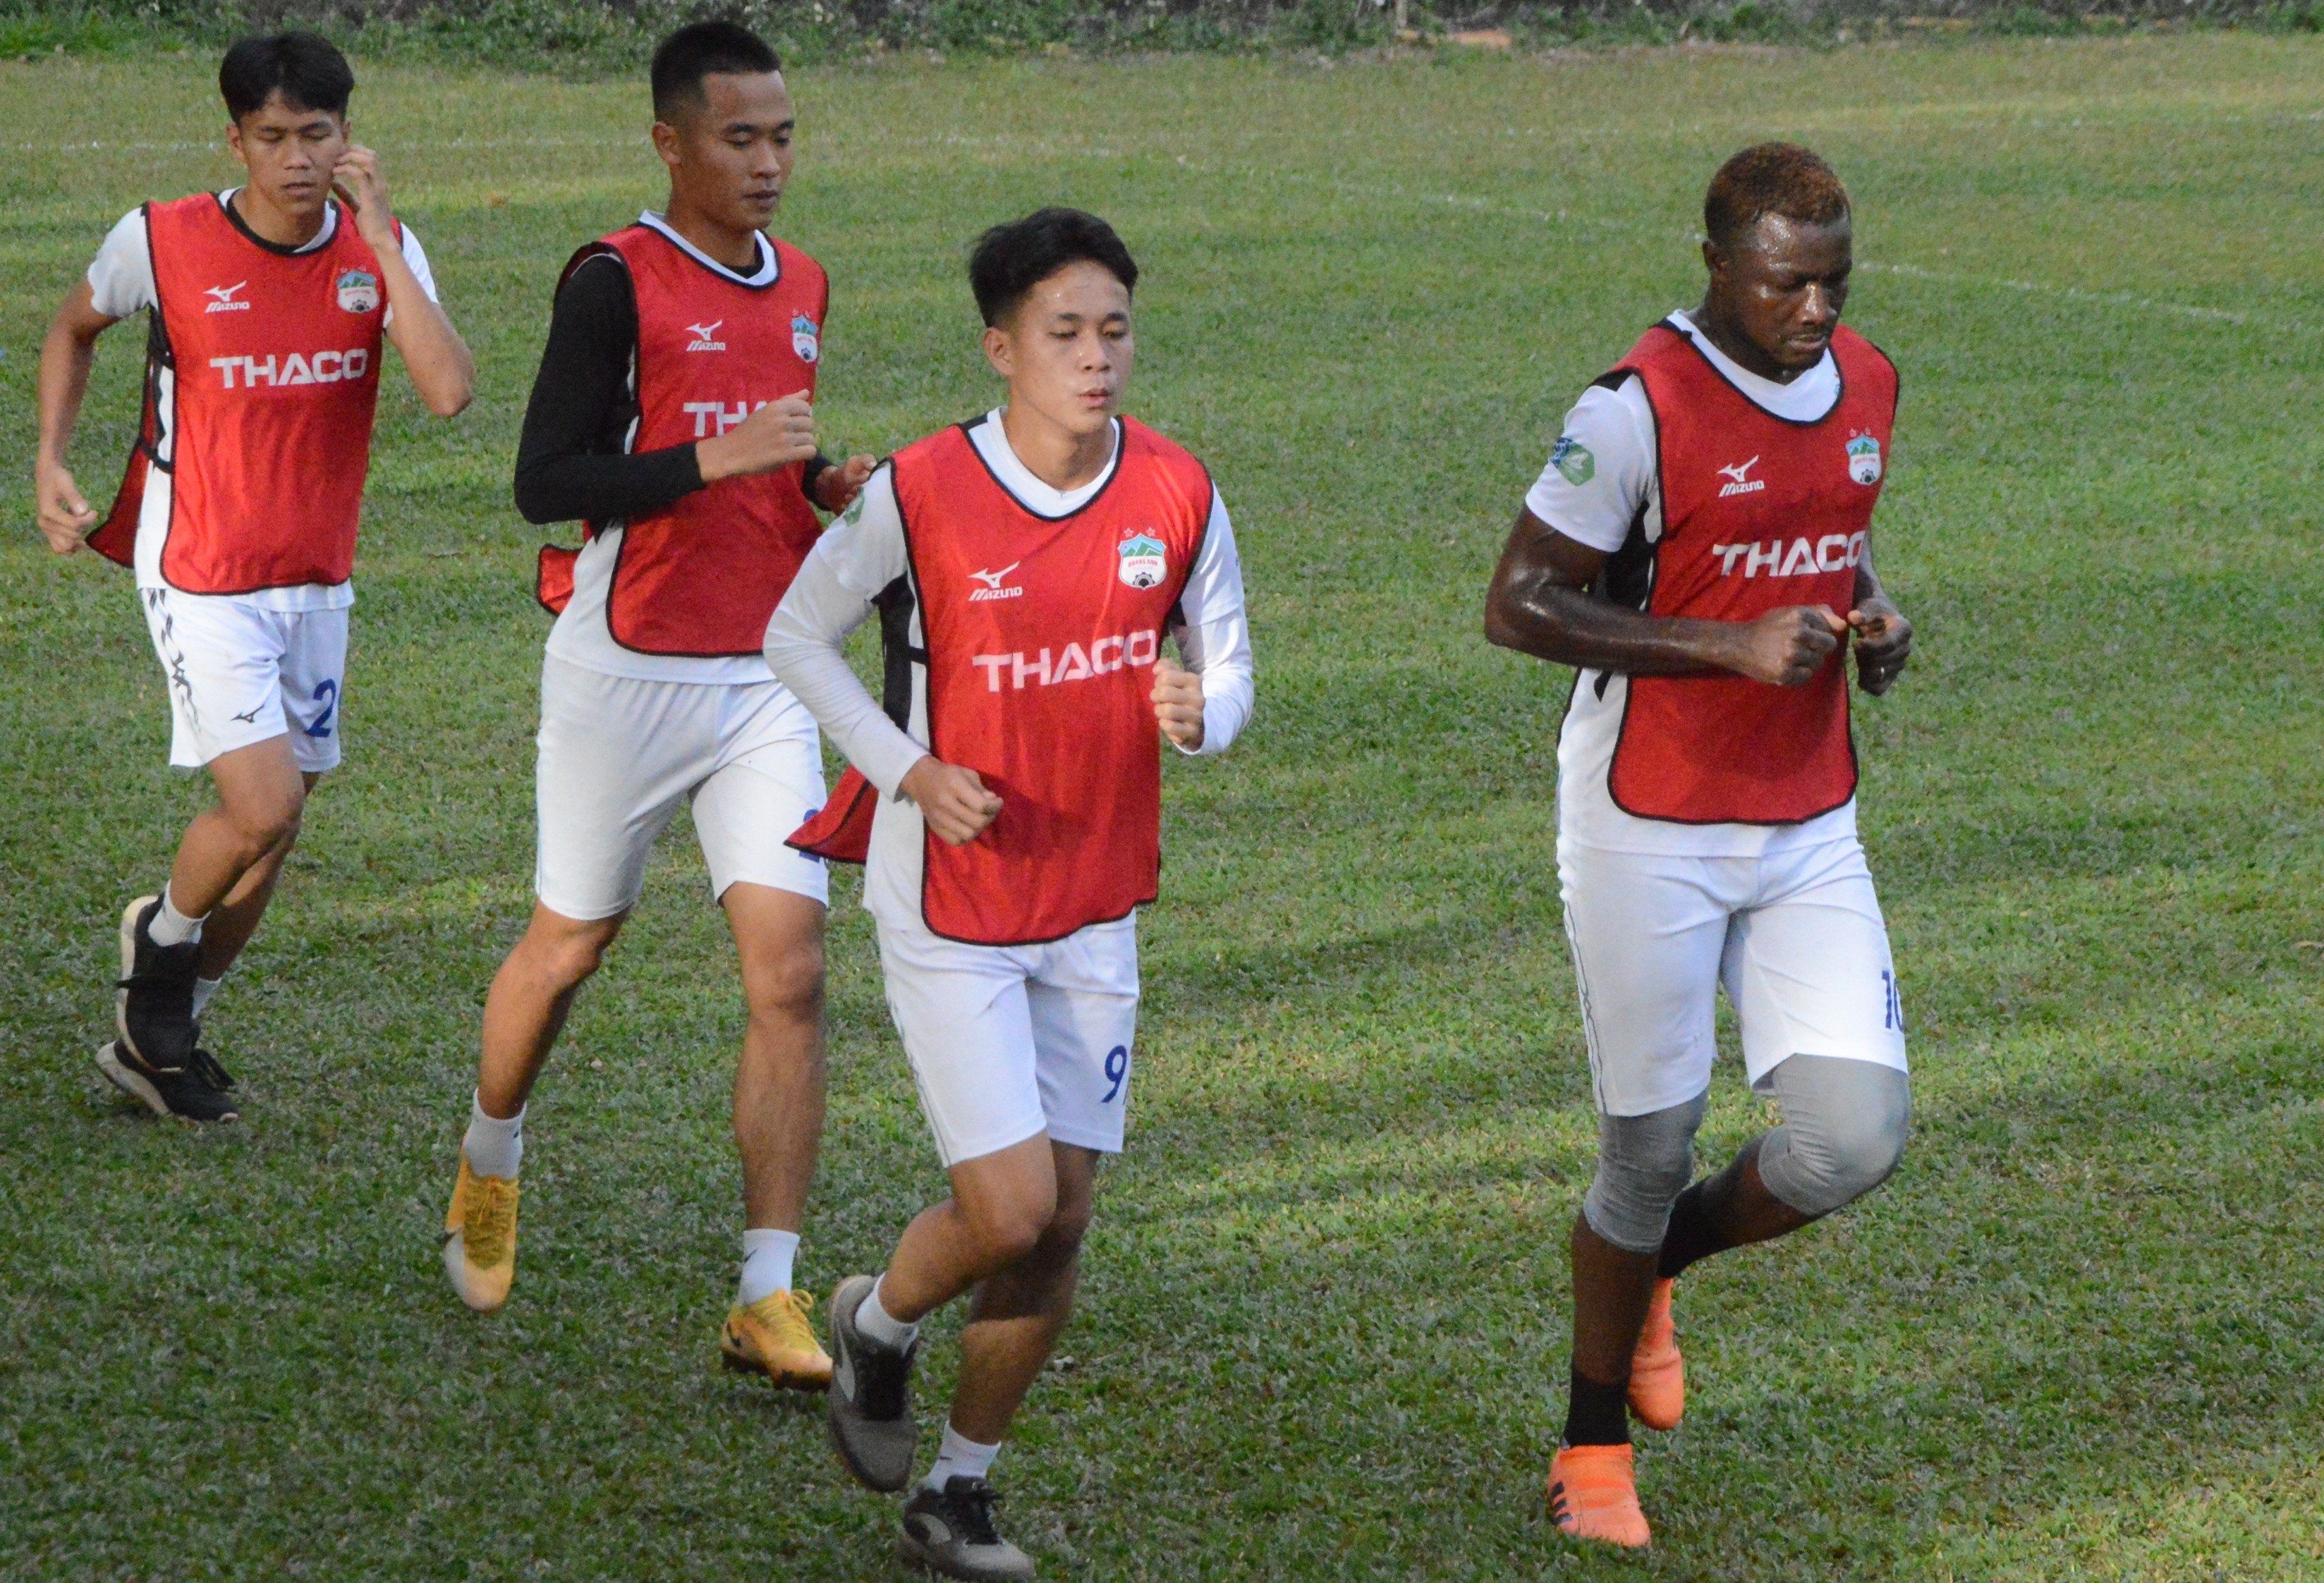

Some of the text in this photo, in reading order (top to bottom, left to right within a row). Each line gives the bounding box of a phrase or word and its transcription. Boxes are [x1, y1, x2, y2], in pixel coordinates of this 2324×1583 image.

[210, 348, 367, 389] THACO
[1712, 530, 1866, 578] THACO
[972, 629, 1157, 692] THACO
[304, 678, 336, 738] 2
[1100, 1045, 1127, 1104] 9
